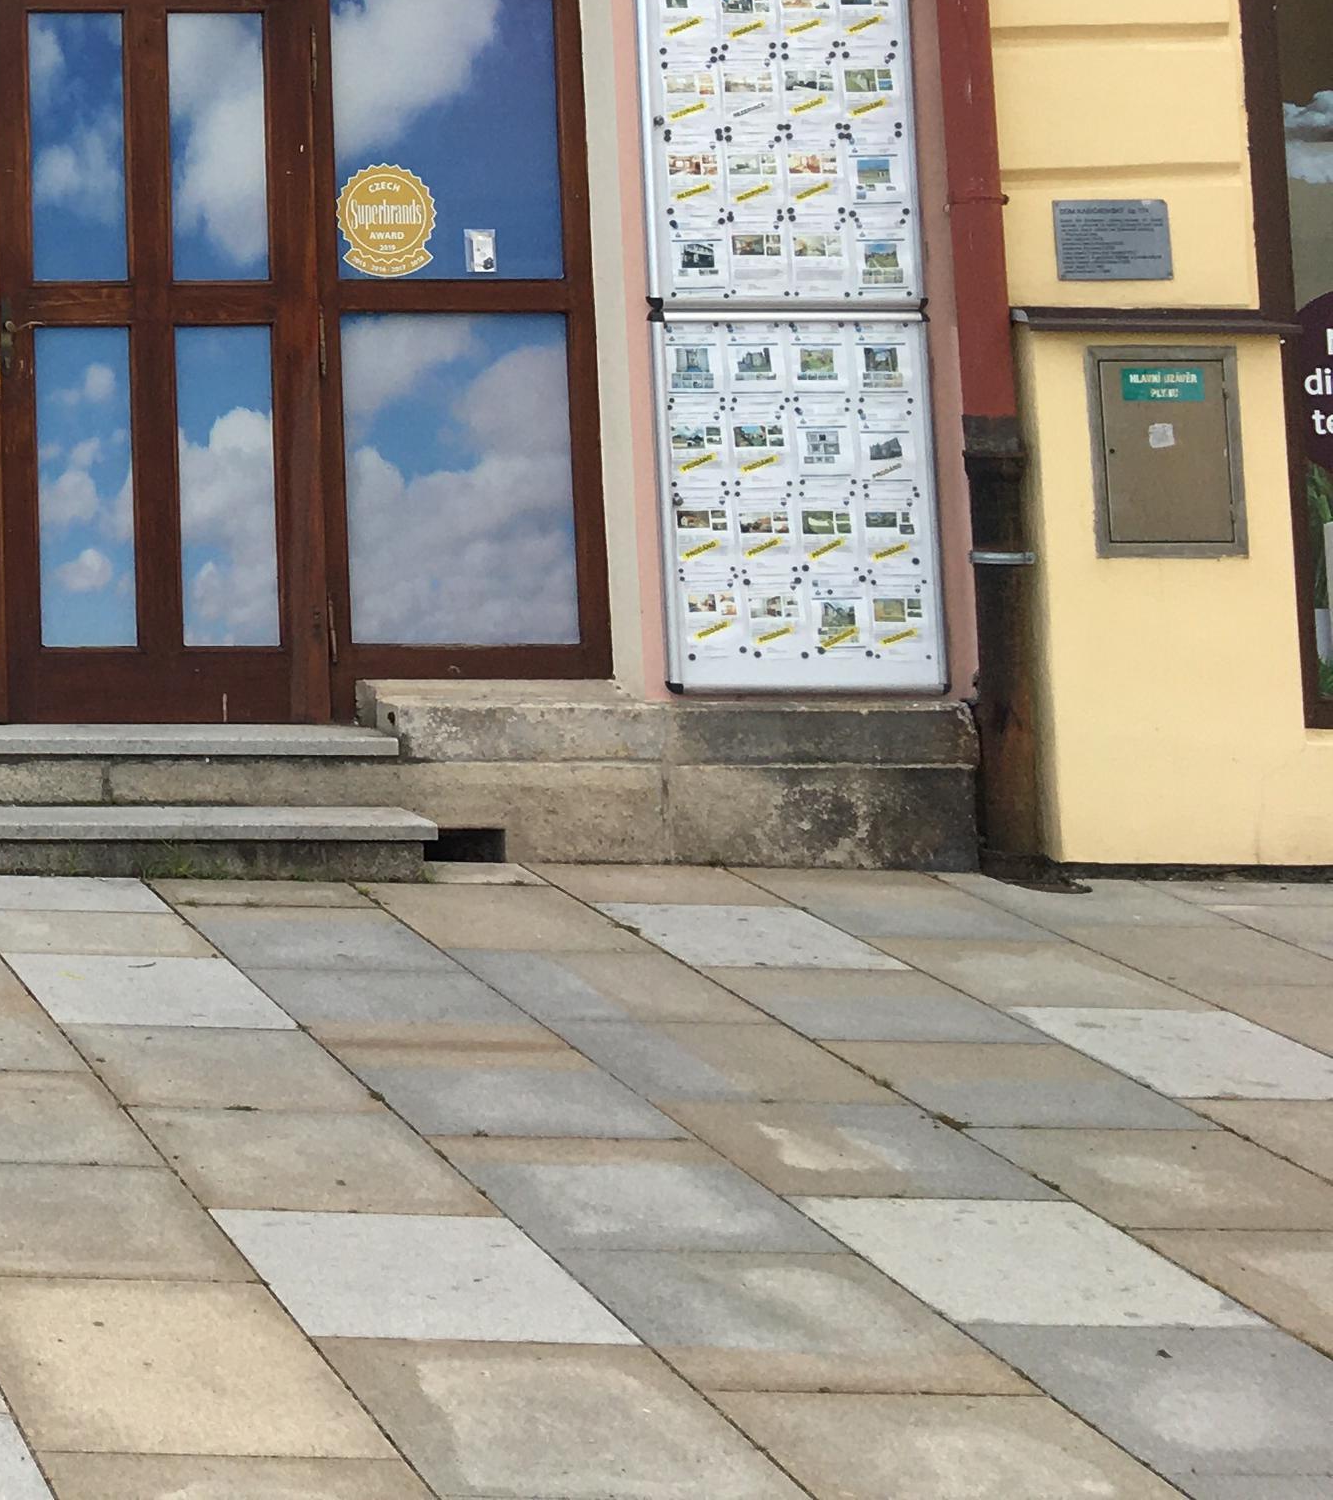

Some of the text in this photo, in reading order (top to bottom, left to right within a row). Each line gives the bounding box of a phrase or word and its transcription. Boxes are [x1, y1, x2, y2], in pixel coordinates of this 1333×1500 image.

[368, 181, 401, 193] CZECH
[350, 199, 422, 230] Superbrands
[369, 231, 405, 240] AWARD
